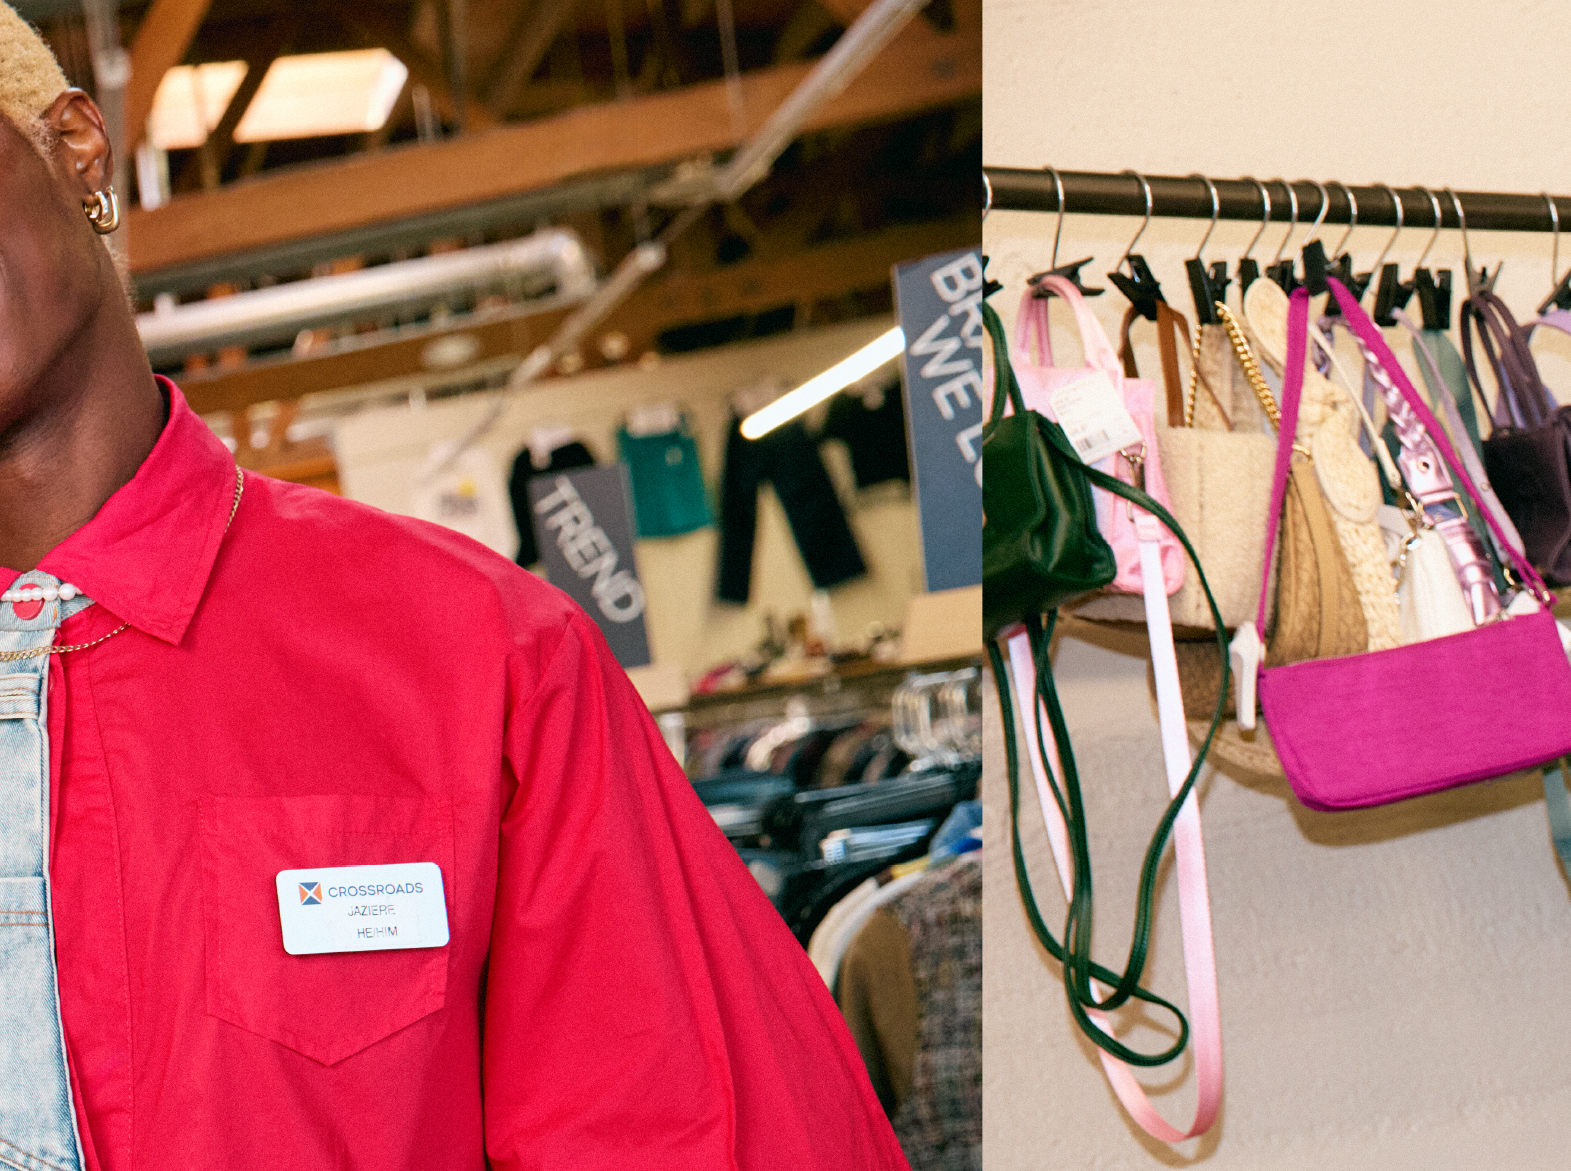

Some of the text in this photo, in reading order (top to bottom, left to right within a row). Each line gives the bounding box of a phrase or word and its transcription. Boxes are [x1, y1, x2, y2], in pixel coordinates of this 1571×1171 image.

[908, 313, 982, 422] WE
[533, 474, 645, 624] TREND
[327, 882, 424, 898] CROSSROADS
[347, 904, 396, 917] JAZIERE
[357, 925, 399, 939] HE/HIM
